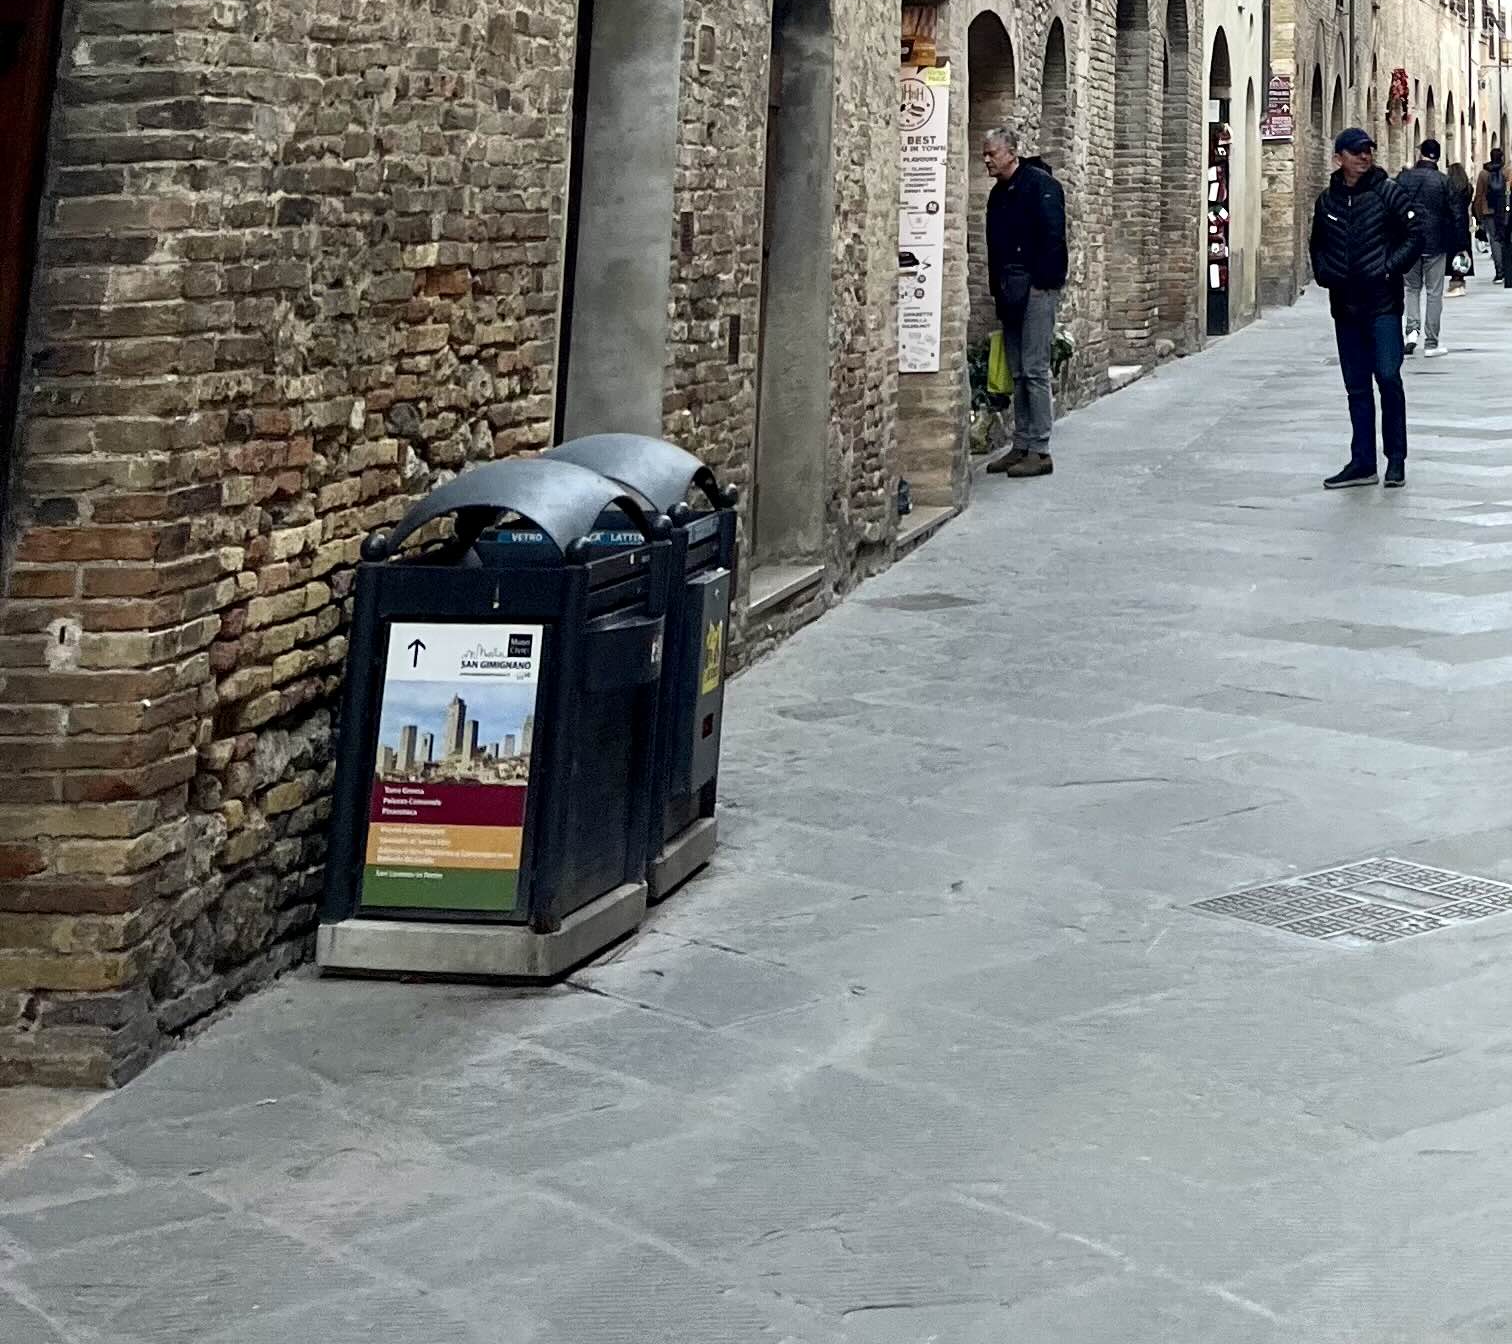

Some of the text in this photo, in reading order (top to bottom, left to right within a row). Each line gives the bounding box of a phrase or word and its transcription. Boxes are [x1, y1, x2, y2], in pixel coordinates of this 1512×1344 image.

[907, 136, 936, 145] BEST
[511, 532, 543, 543] VETRO
[461, 660, 531, 670] SAN GIMIGNANO
